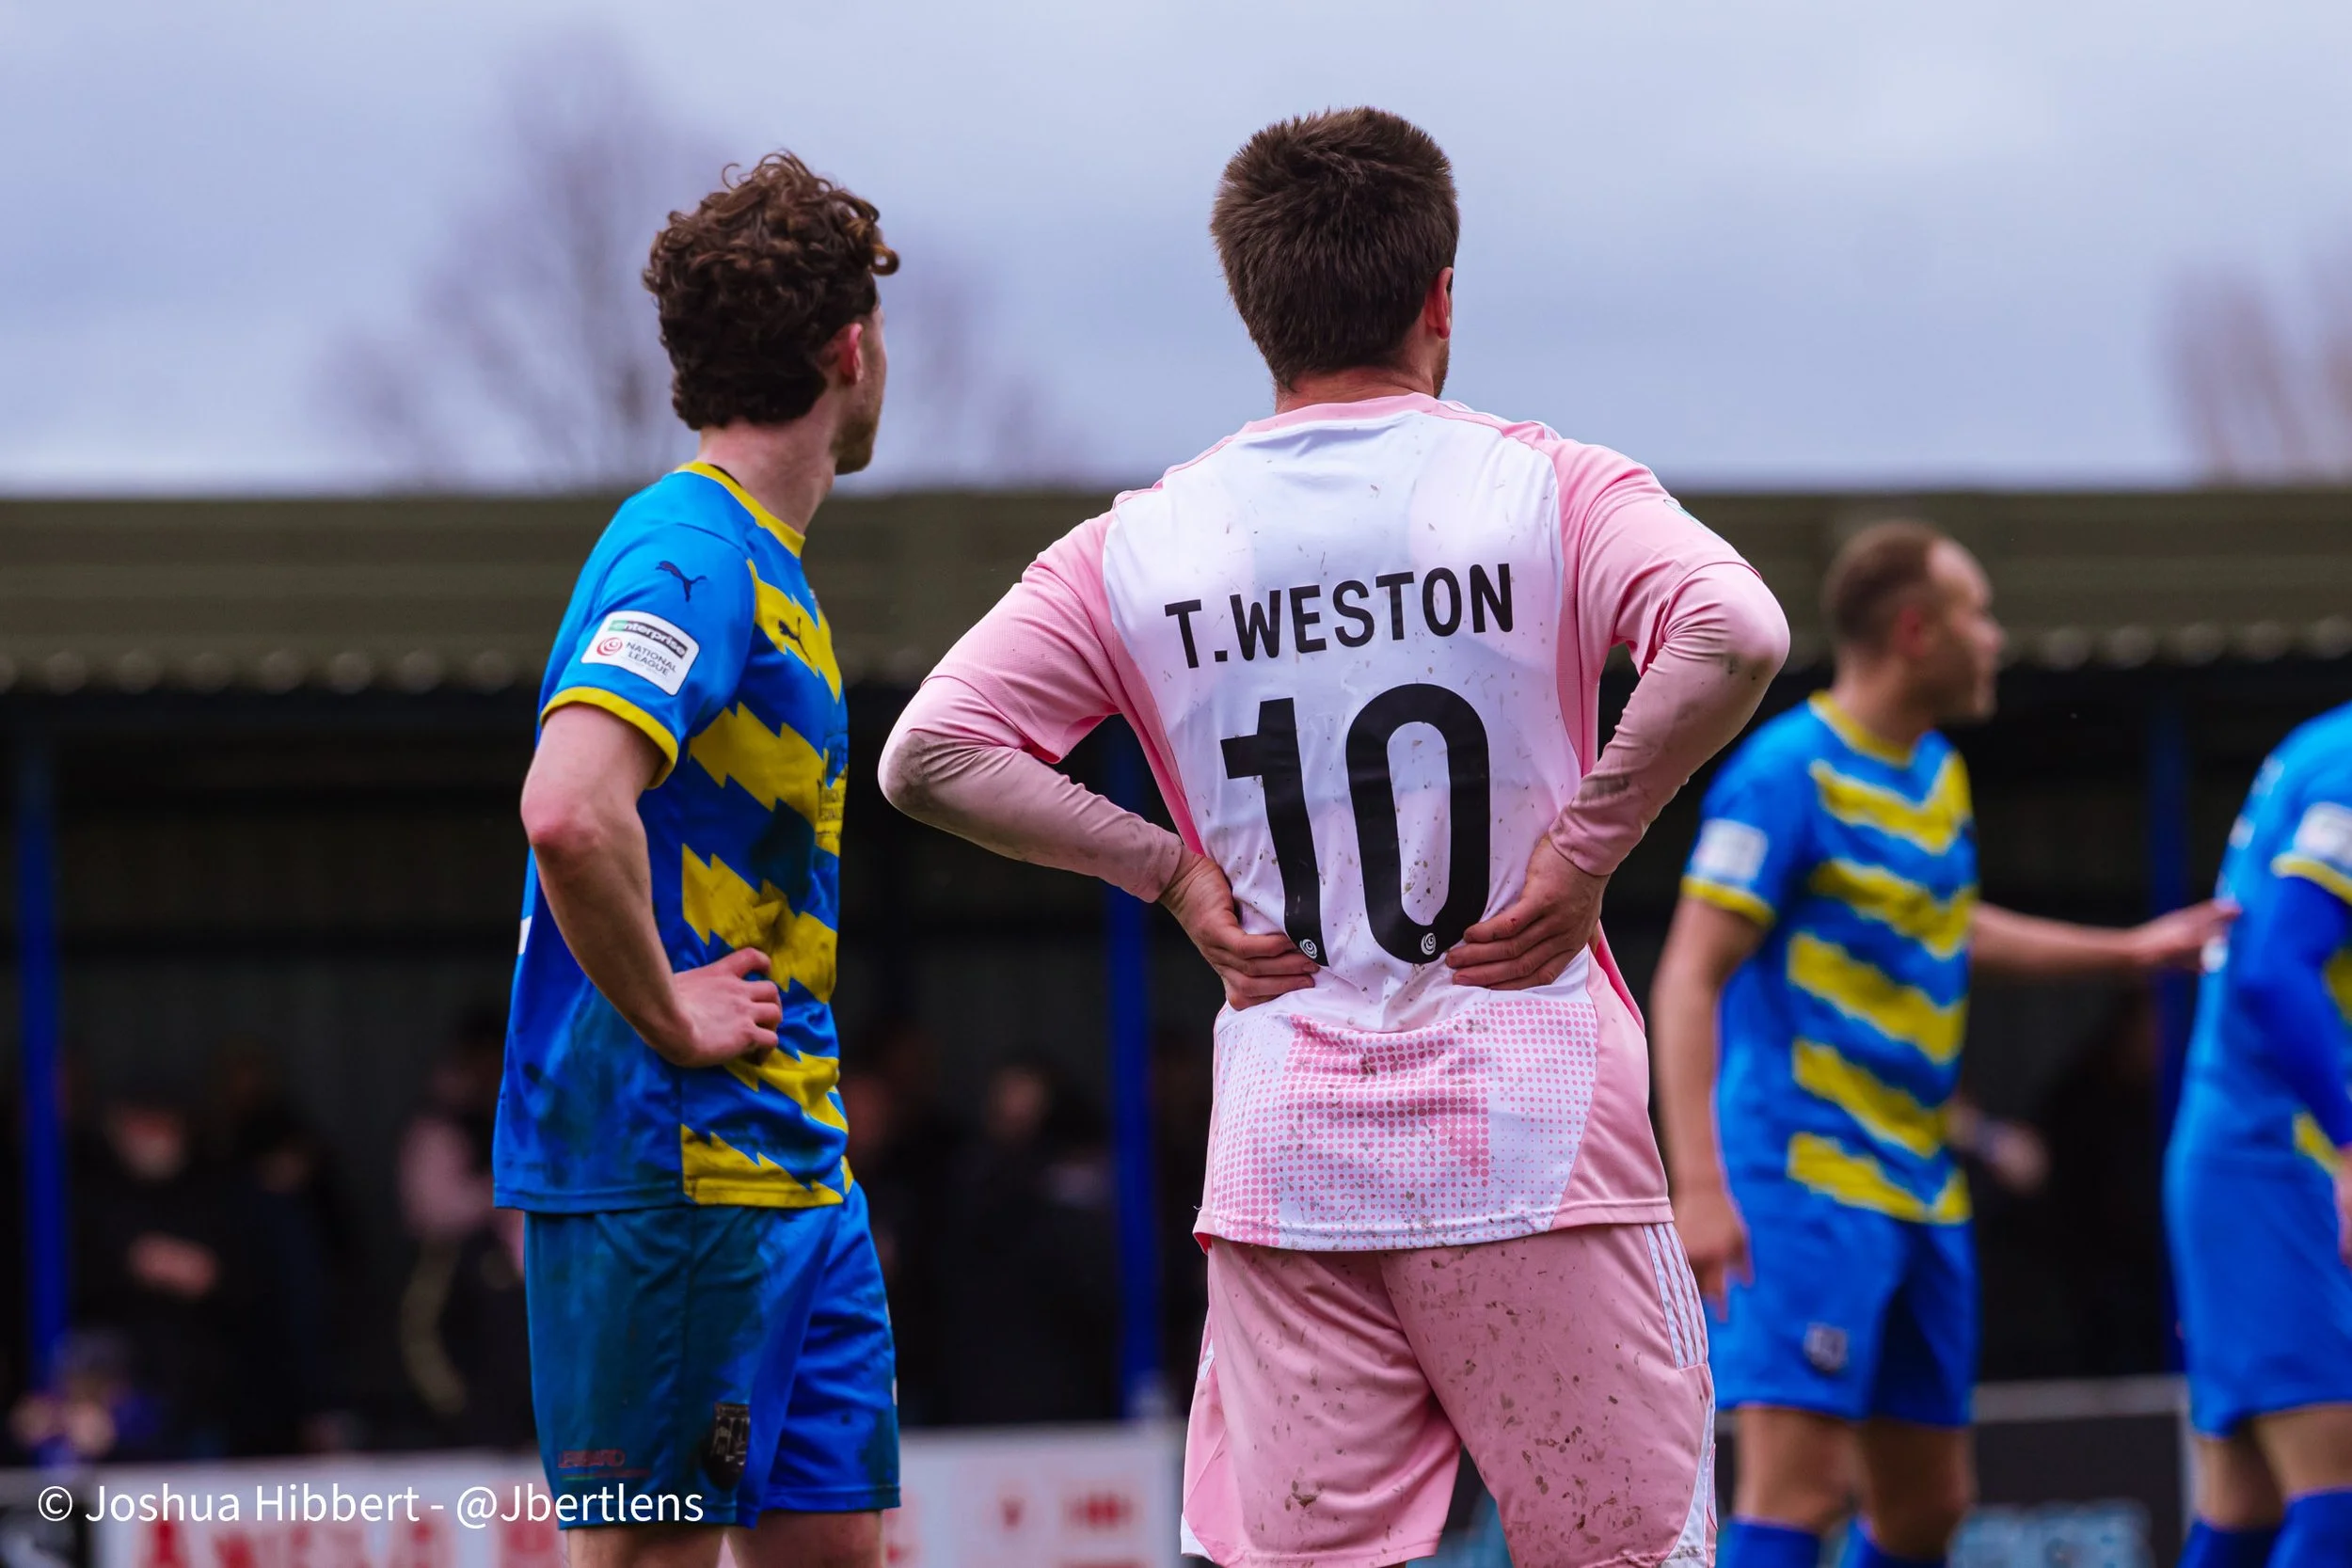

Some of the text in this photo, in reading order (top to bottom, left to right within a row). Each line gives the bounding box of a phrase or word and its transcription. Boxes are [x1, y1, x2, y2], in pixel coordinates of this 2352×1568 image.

[1165, 563, 1514, 669] T.WESTON
[610, 622, 686, 657] enterprise
[626, 641, 677, 673] NATIONAL
[628, 651, 671, 676] LEAGUE
[1220, 683, 1490, 967] 10
